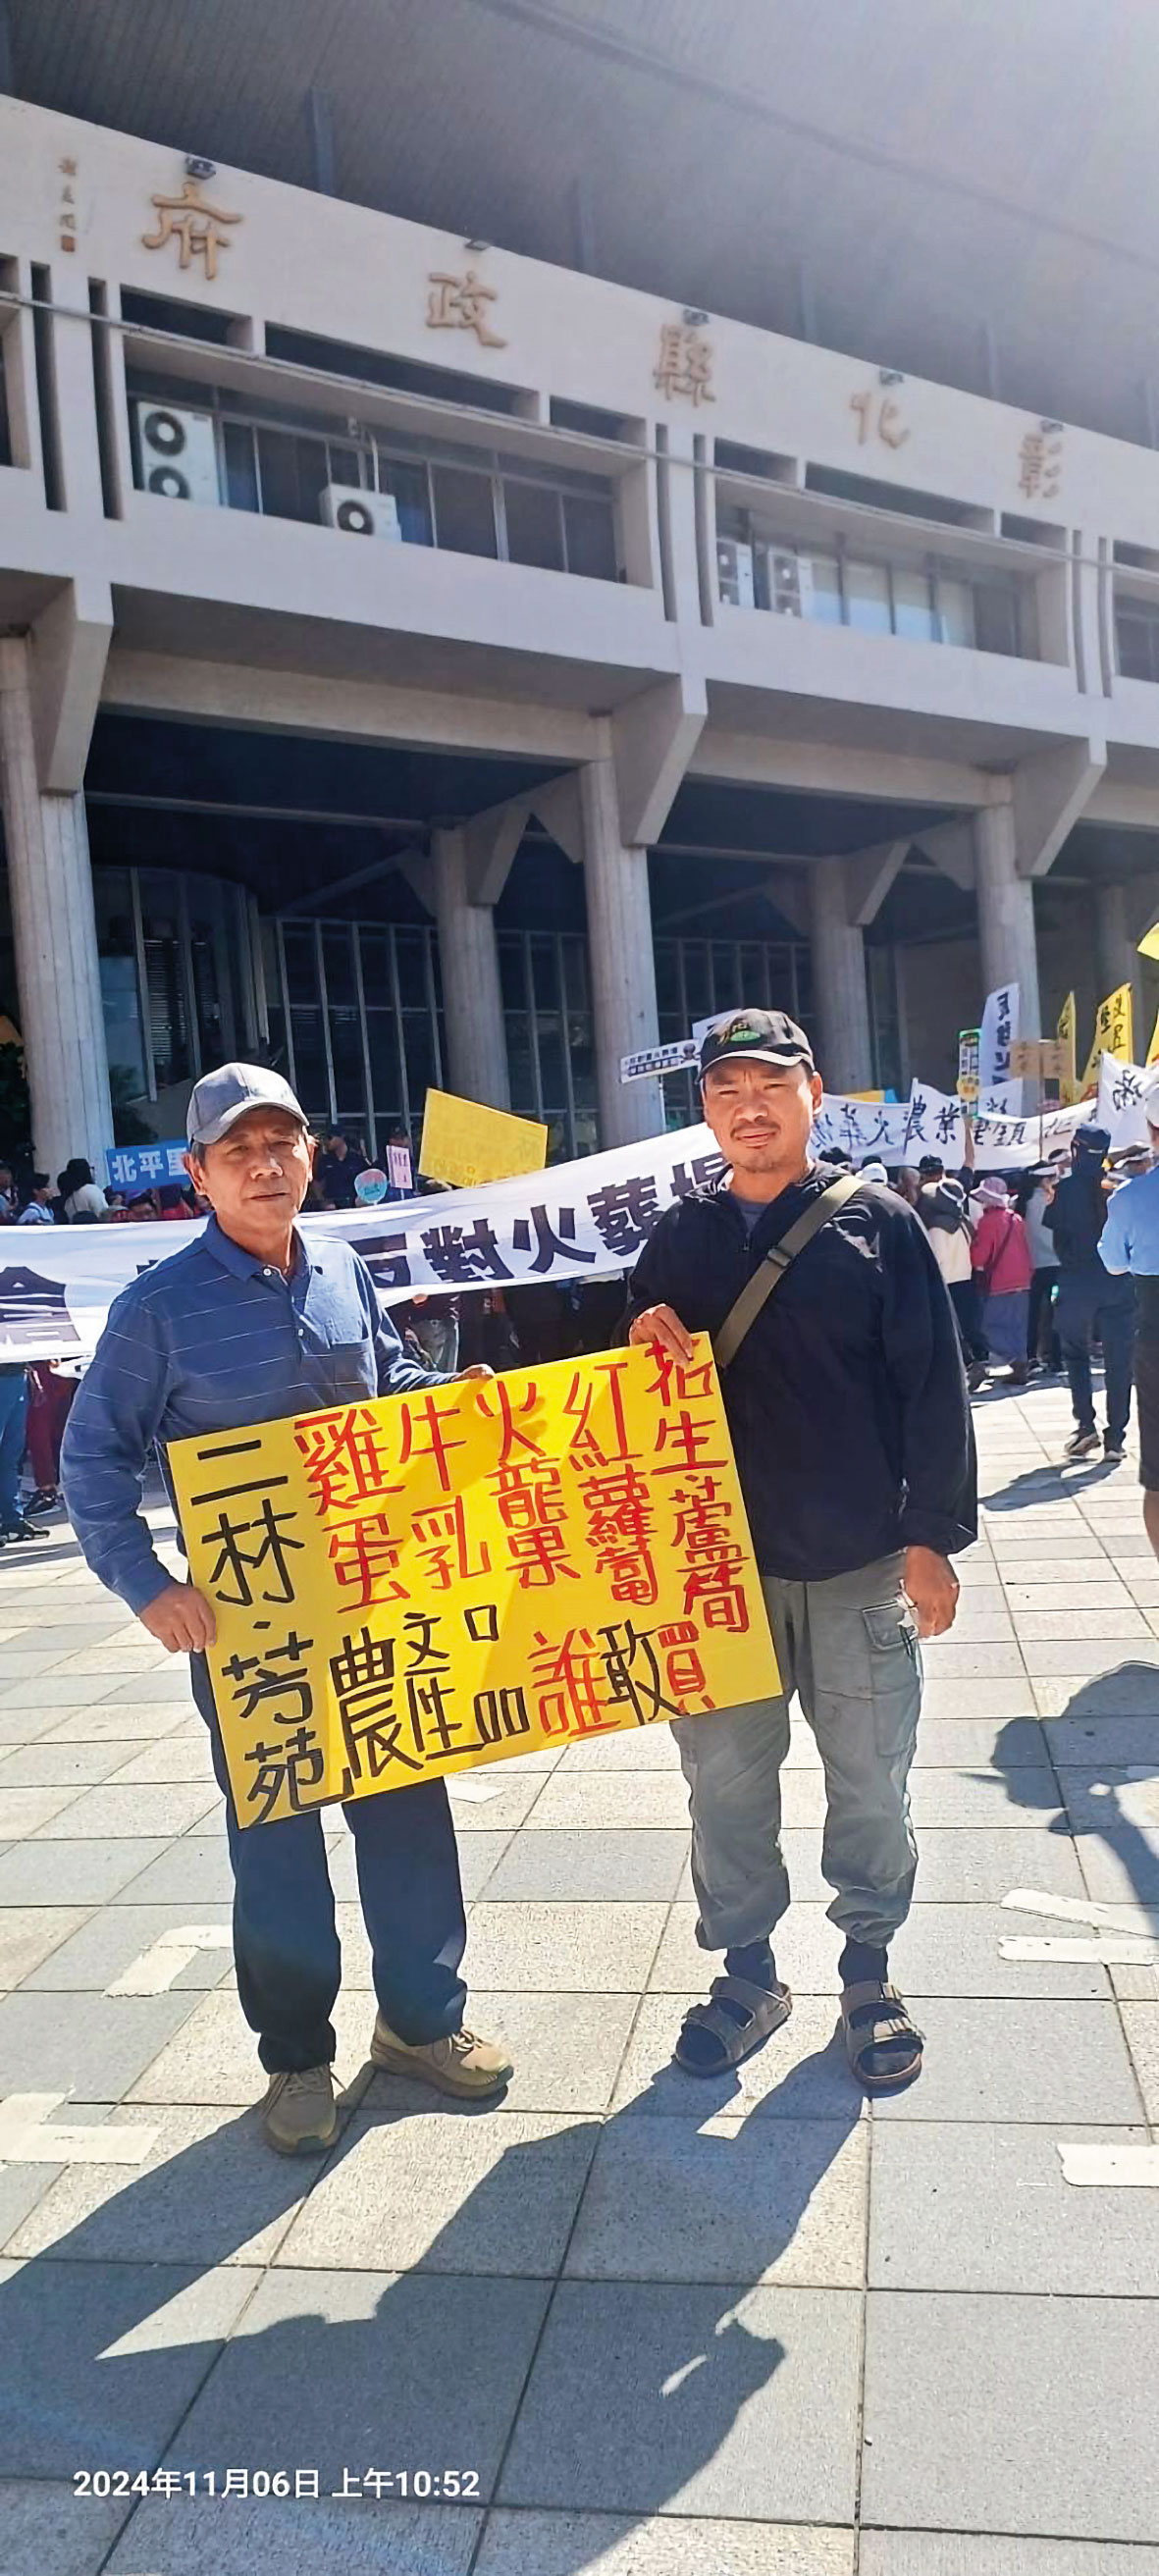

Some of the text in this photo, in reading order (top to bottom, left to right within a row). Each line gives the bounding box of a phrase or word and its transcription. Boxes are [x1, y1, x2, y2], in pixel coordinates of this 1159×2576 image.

[294, 1407, 411, 1614] 雞蛋
[399, 1394, 490, 1591] 牛乳
[475, 1380, 581, 1589] 火龍果
